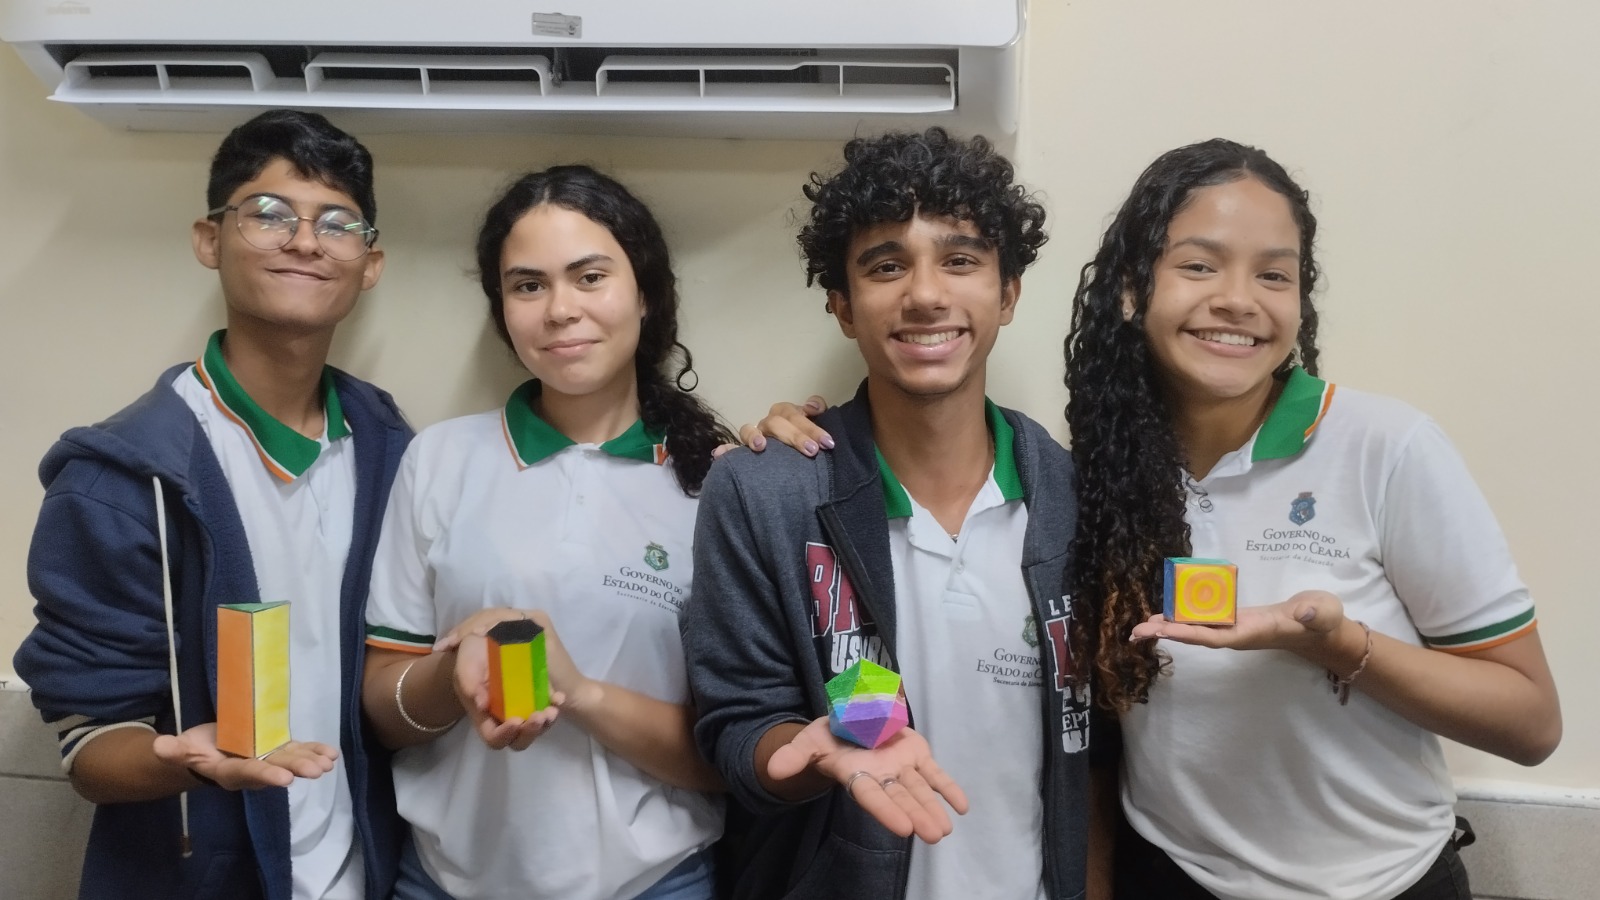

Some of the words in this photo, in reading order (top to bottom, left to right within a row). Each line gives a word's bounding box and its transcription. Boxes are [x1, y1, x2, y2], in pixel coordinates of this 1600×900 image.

[1263, 528, 1320, 541] GOVERNO
[1245, 539, 1290, 552] ESTADO
[602, 574, 648, 594] ESTADO
[620, 566, 673, 590] GOVERNO
[993, 647, 1041, 666] GOVERN
[976, 658, 1020, 677] ESTADO
